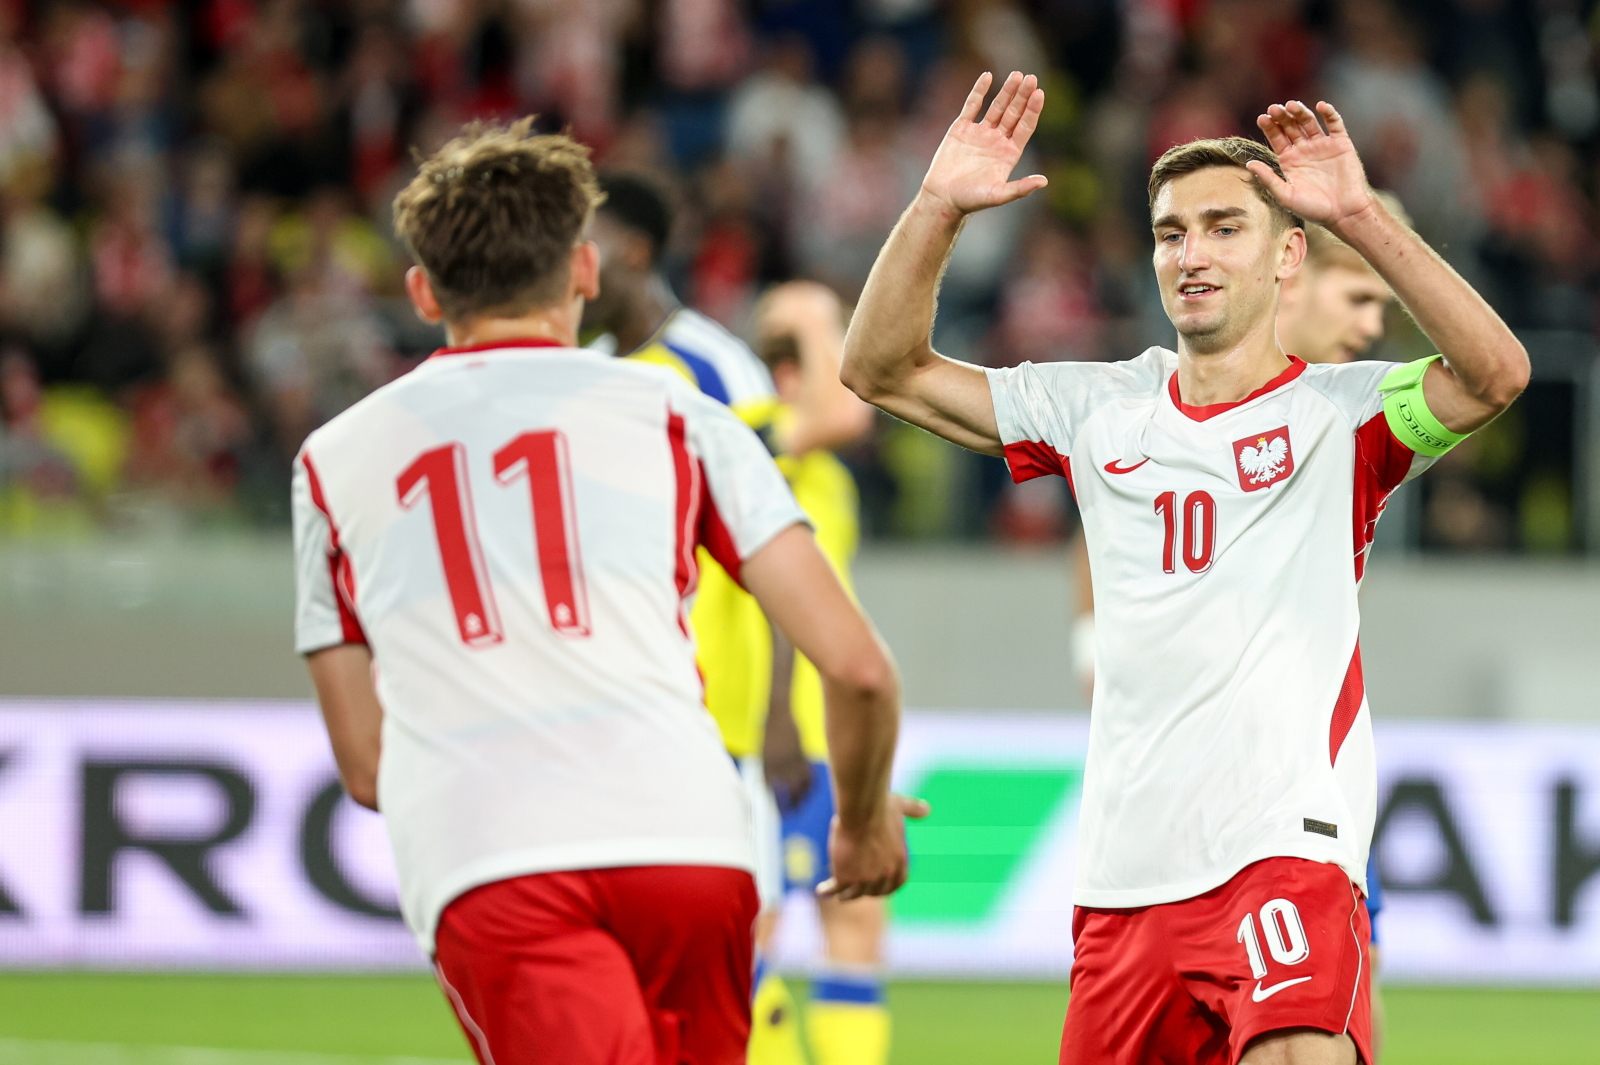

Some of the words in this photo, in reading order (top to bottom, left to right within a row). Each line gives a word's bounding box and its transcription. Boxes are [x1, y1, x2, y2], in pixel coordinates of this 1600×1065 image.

[1399, 402, 1452, 448] RESPECT
[395, 427, 593, 650] 11
[1154, 490, 1217, 574] 10
[1237, 898, 1310, 979] 10
